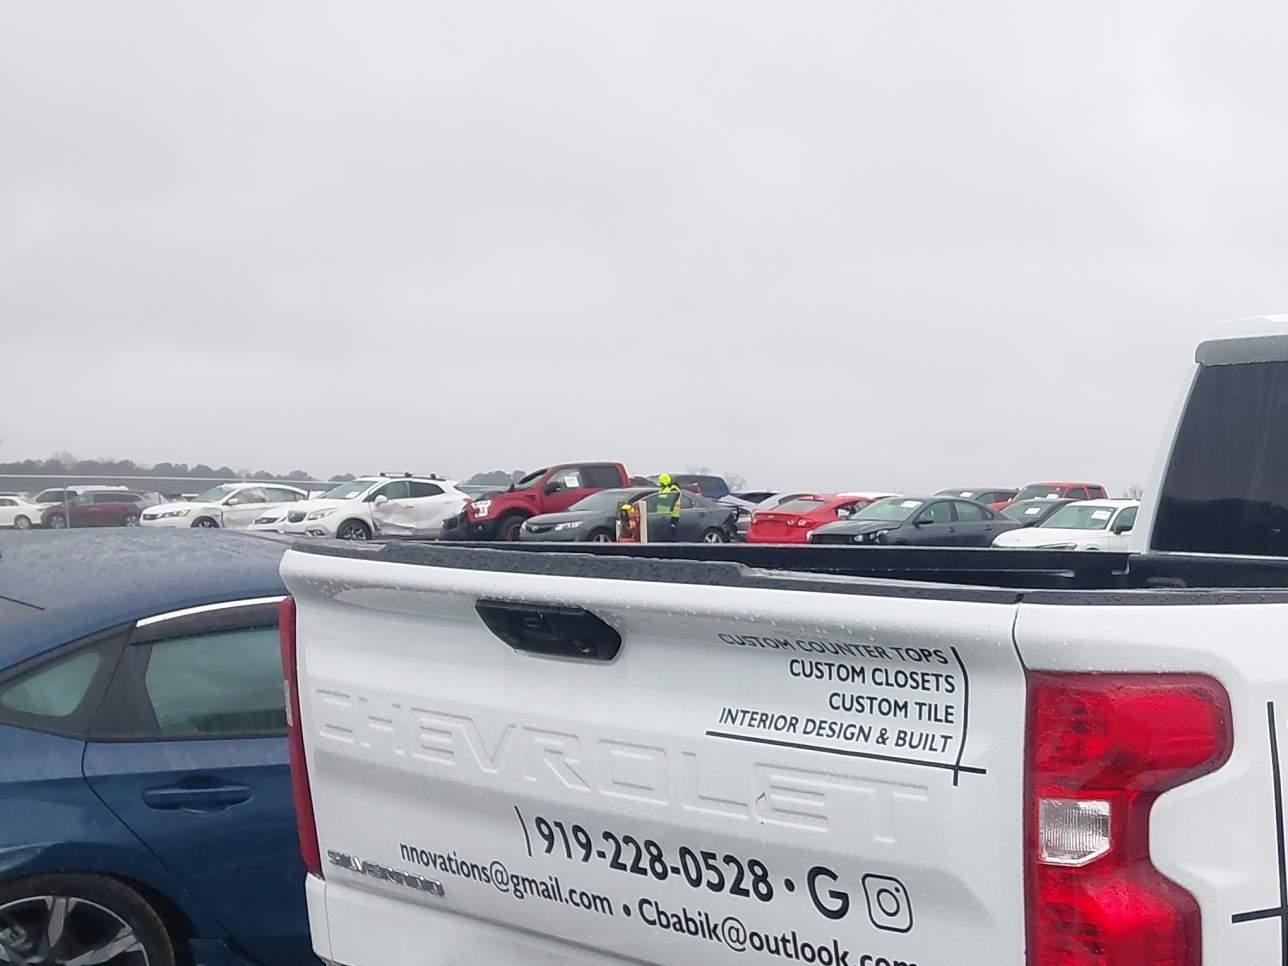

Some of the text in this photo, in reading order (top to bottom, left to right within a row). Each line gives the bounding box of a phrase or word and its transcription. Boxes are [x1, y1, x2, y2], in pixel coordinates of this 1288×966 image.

[718, 632, 949, 665] CUSTOM COUNTER TOPS
[789, 658, 955, 693] CUSTOM CLOSETS
[718, 707, 953, 753] INTERIOR DESIGN & BUILT
[829, 692, 955, 724] CUSTOM TILE
[314, 687, 930, 845] CHEVROLET
[399, 842, 614, 916] nnovations@gmail.com
[534, 816, 775, 903] 919-228-0528
